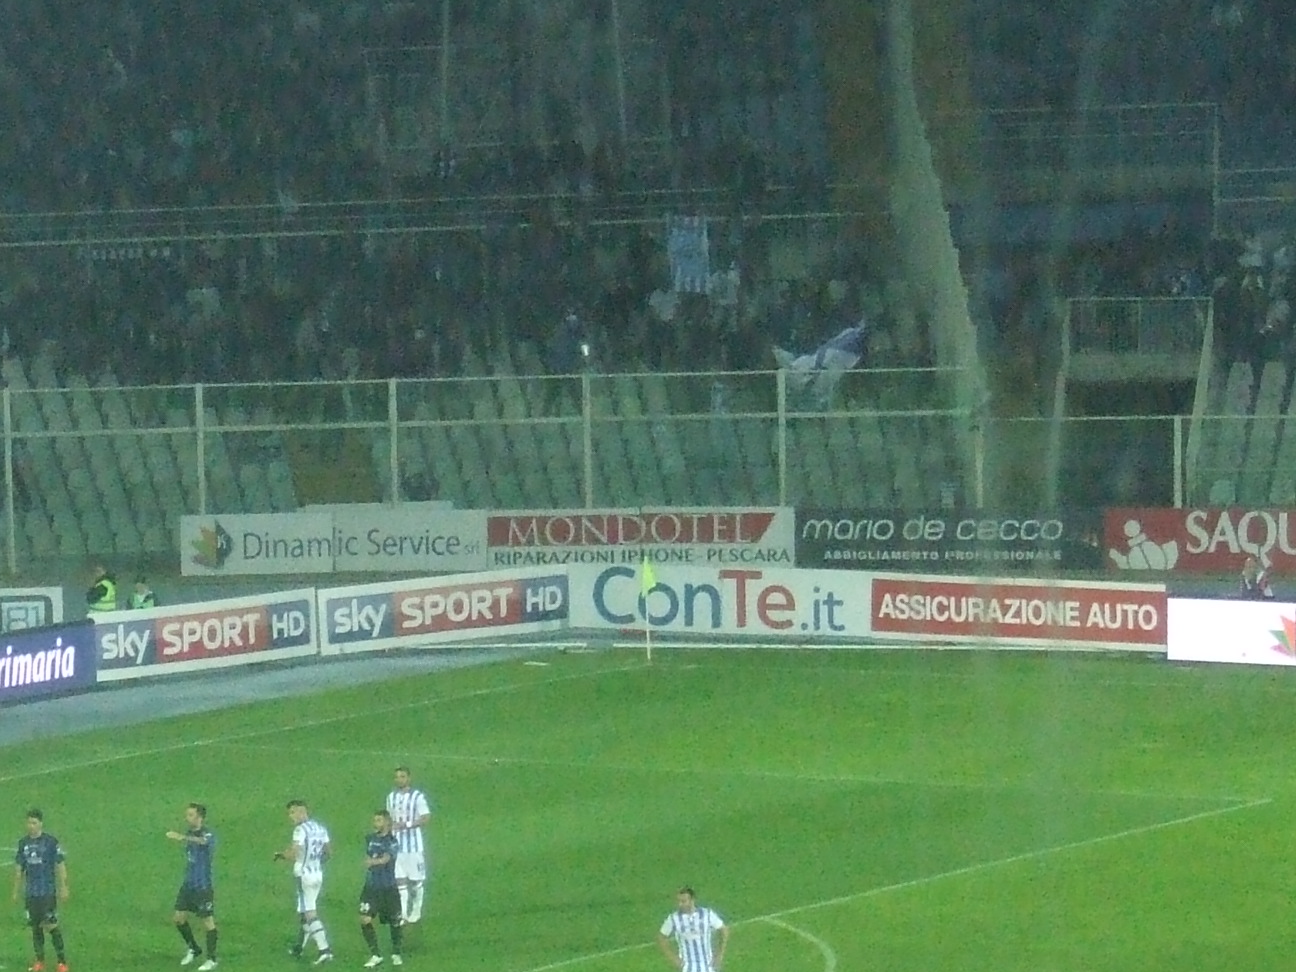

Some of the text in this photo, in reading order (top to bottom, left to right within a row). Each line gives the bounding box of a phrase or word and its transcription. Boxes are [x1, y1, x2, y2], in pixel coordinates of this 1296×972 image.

[243, 529, 358, 559] Dinamic
[367, 527, 461, 556] Service
[507, 513, 753, 546] MONDOTEL
[803, 515, 1064, 540] mario de cecco
[493, 548, 615, 566] RIPARAZIONI
[707, 547, 791, 563] PESCARA
[333, 584, 562, 637] sky SPORT HD
[592, 566, 846, 631] ConTe.it
[878, 593, 1158, 631] ASSICURAZIONE AUTO
[102, 609, 305, 664] sky SPORT HD
